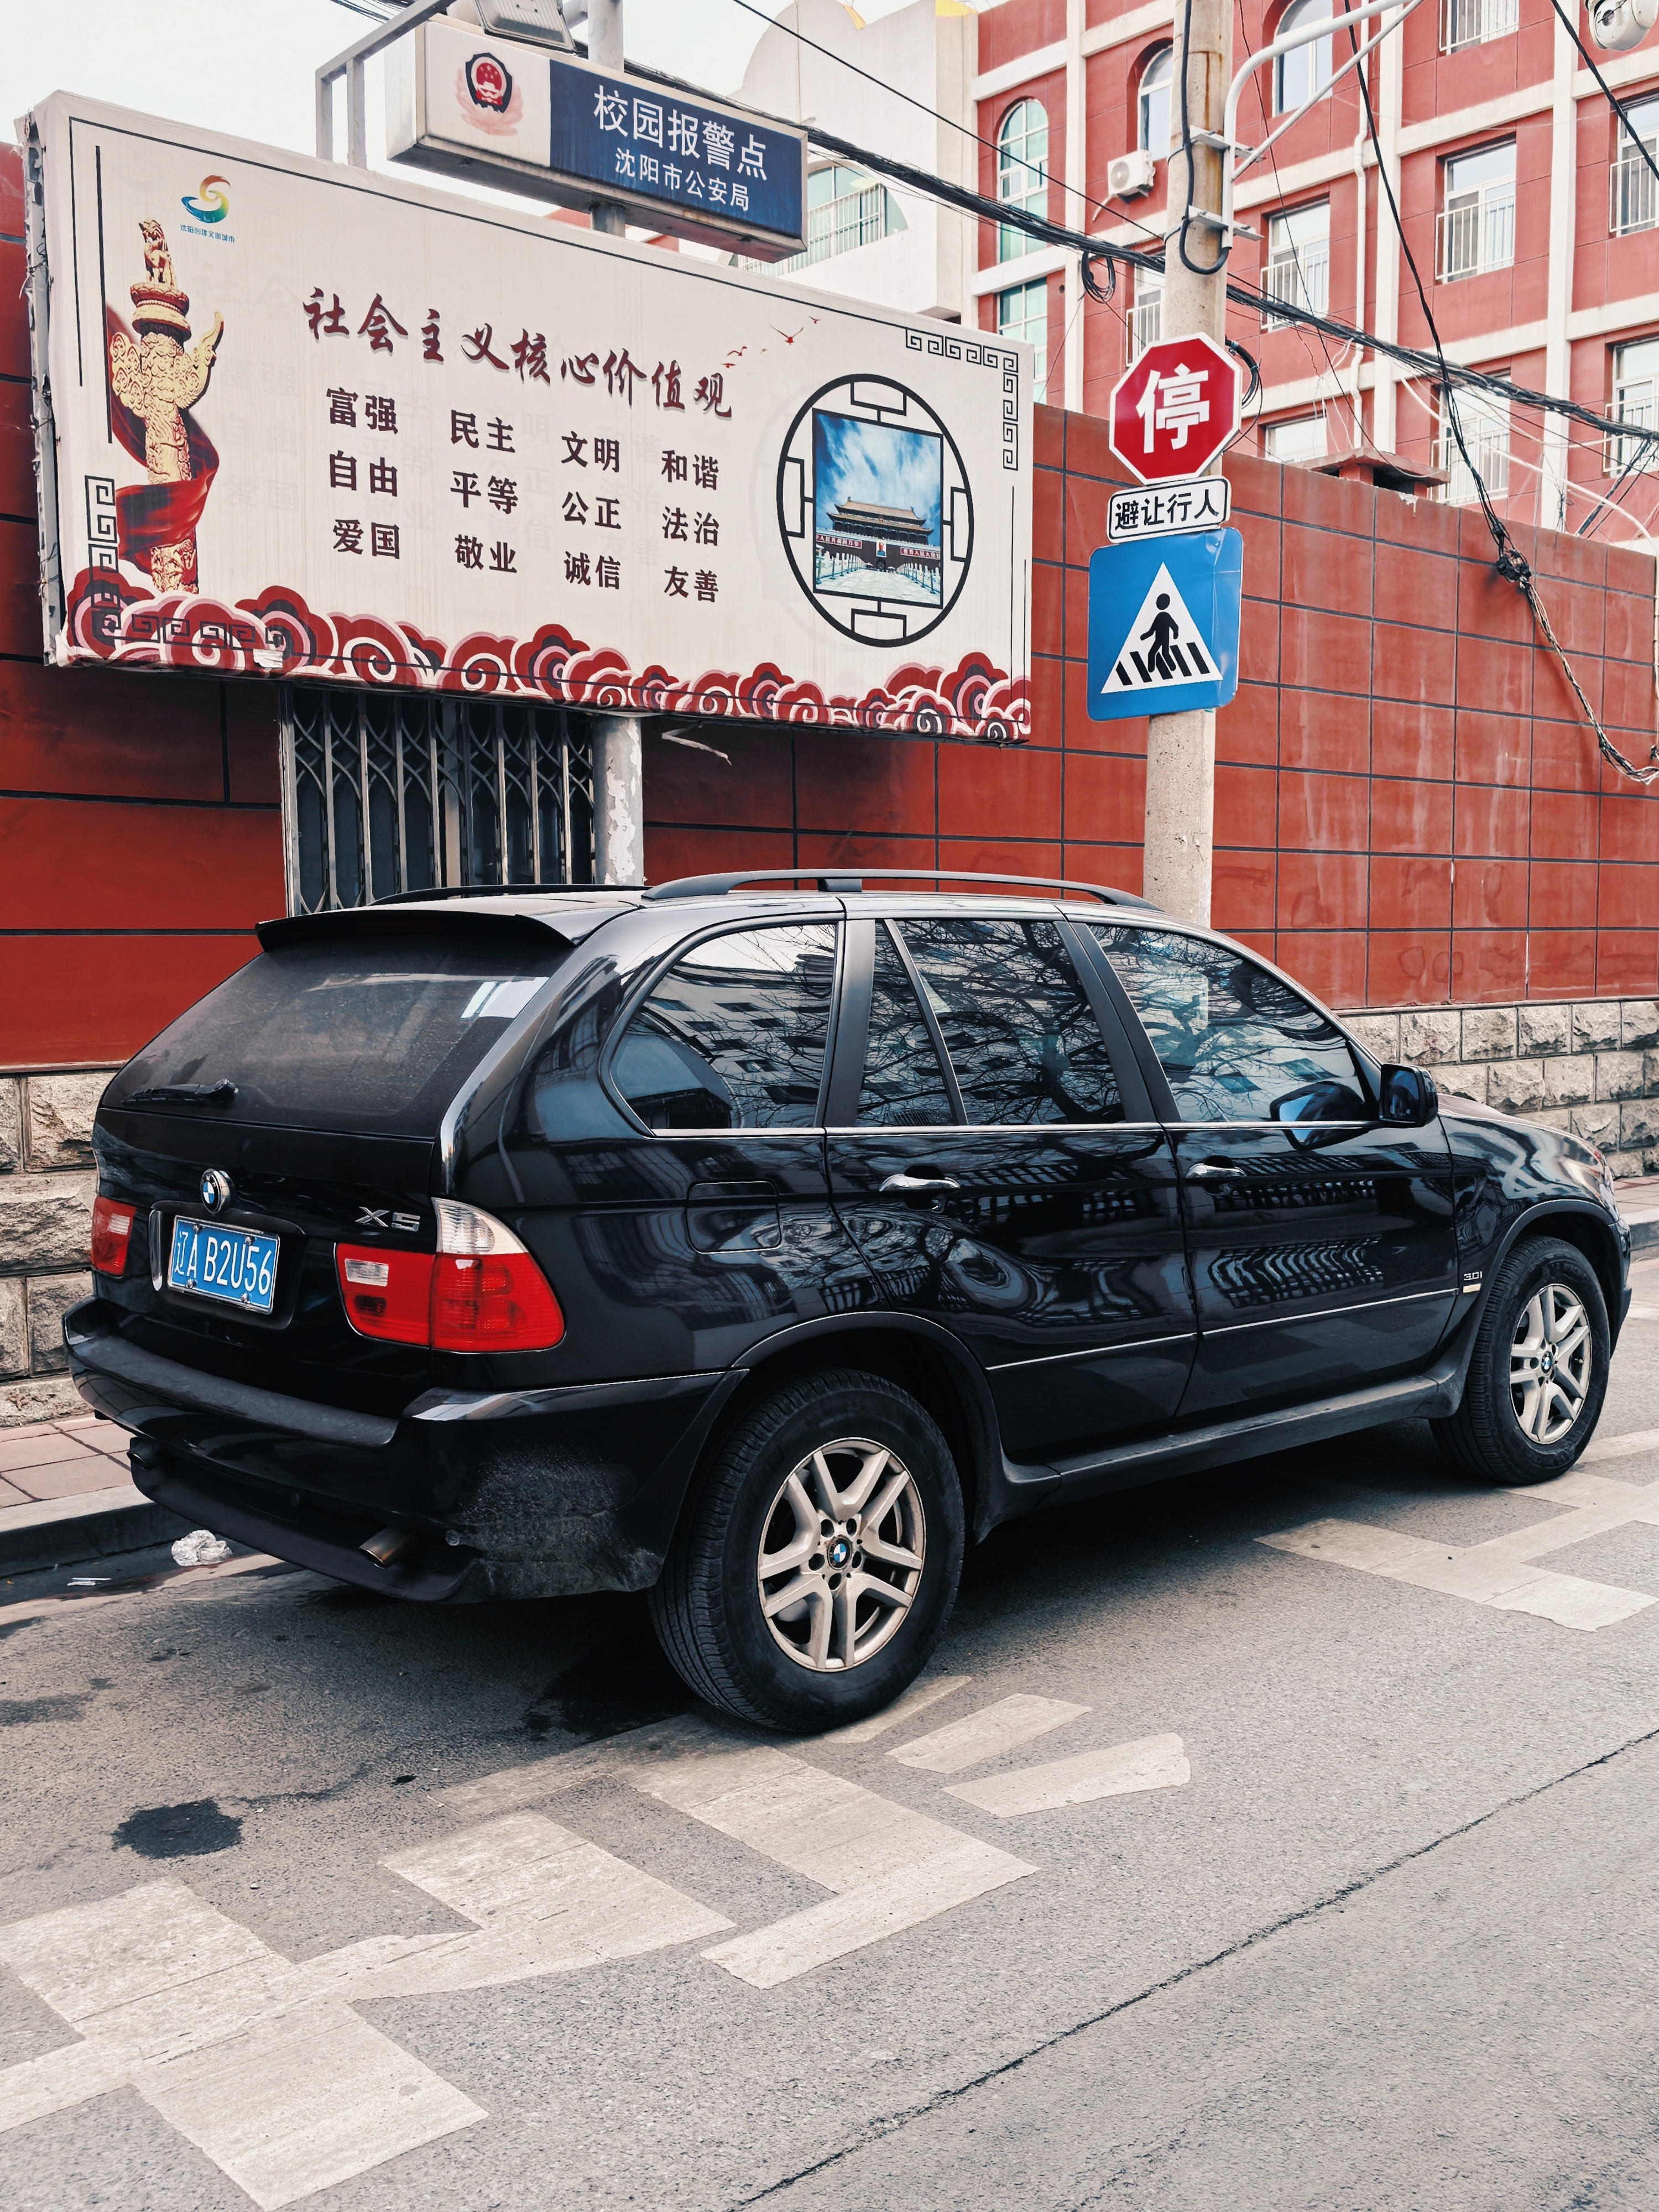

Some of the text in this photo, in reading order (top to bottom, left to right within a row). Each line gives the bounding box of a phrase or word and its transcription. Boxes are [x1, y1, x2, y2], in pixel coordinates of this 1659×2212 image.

[593, 85, 767, 181] 校园报警点
[615, 147, 749, 211] 沈阳市公安局
[302, 287, 732, 419] 社会主义核心价值观
[326, 388, 719, 491] 富强 民主 文明 和谐
[1136, 363, 1209, 453] 停
[330, 450, 719, 546] 自由 平等 公正 法治
[1115, 489, 1219, 531] 避让行人
[333, 519, 718, 602] 爱国 敬业 诚信 友善
[354, 1206, 421, 1232] X5
